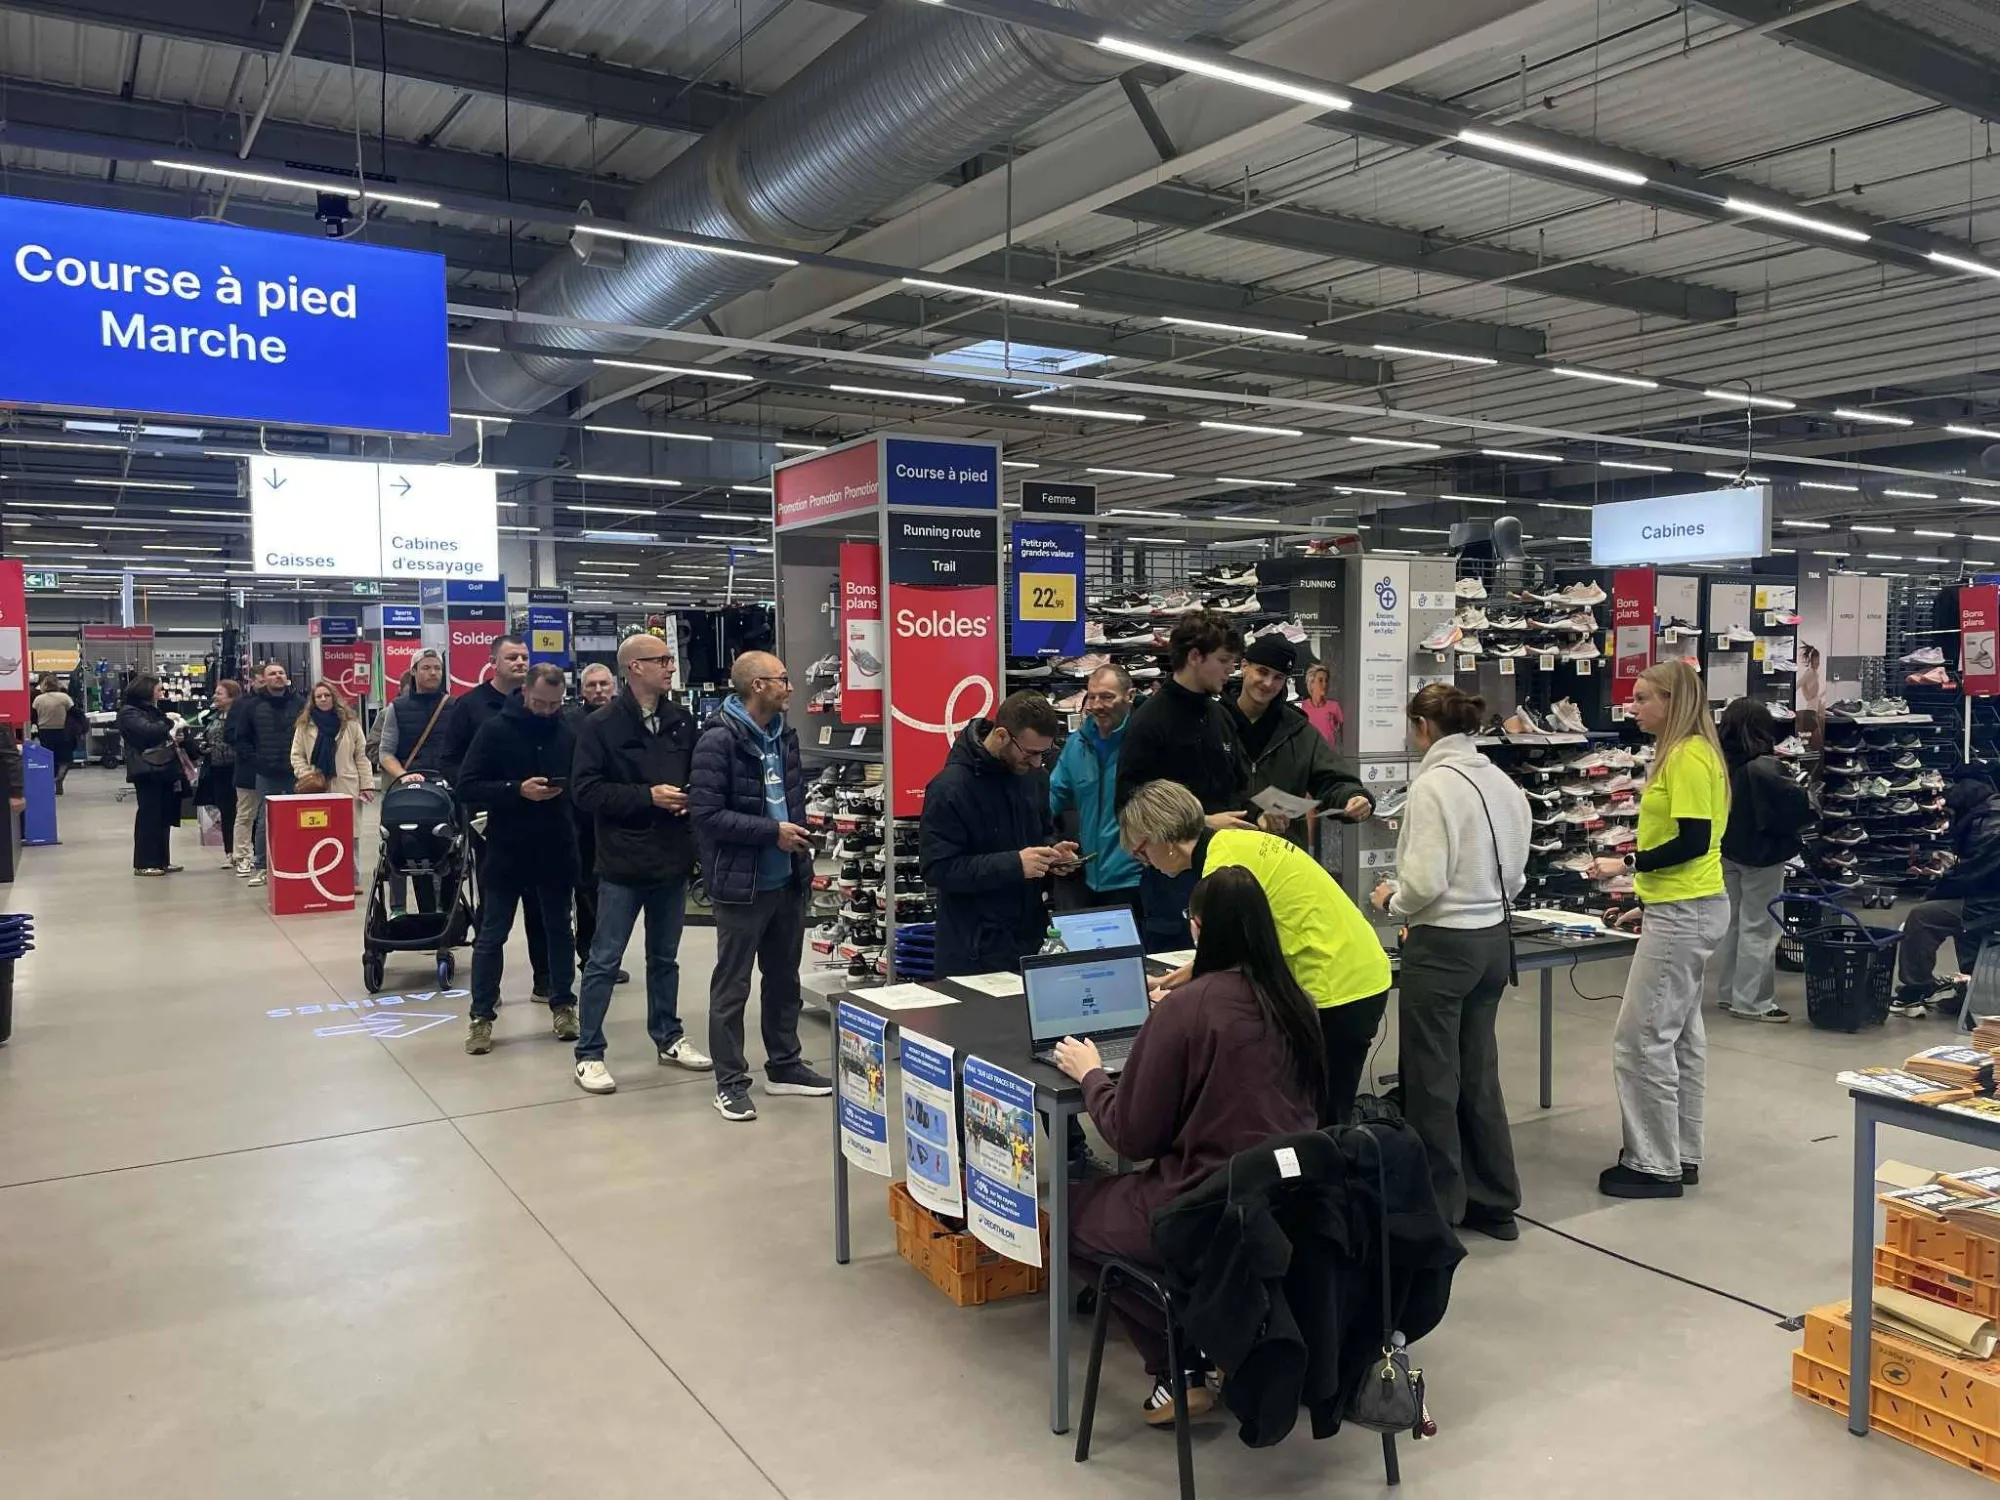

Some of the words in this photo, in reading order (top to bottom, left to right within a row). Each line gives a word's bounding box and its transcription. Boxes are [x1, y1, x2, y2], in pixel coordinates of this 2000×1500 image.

[14, 243, 202, 300] Course
[215, 264, 243, 306] à
[258, 275, 358, 319] pied
[100, 309, 288, 364] Marche
[895, 464, 946, 481] Course
[948, 465, 957, 482] à
[959, 468, 989, 484] pied
[777, 498, 808, 516] Promotion
[809, 489, 843, 508] Promotion
[1041, 492, 1077, 506] Femme
[903, 524, 950, 540] Running
[951, 527, 982, 539] route
[1641, 521, 1706, 541] Cabines
[391, 536, 458, 553] Cabines
[265, 552, 336, 569] Caisses
[392, 556, 485, 575] d'essayage
[931, 560, 956, 573] Trail
[846, 582, 877, 596] Bons
[846, 596, 877, 612] plans
[1616, 598, 1639, 608] Bons
[1616, 609, 1640, 620] plans
[1962, 609, 1984, 618] Bons
[1962, 618, 1985, 629] plans
[265, 988, 471, 1018] CABINES
